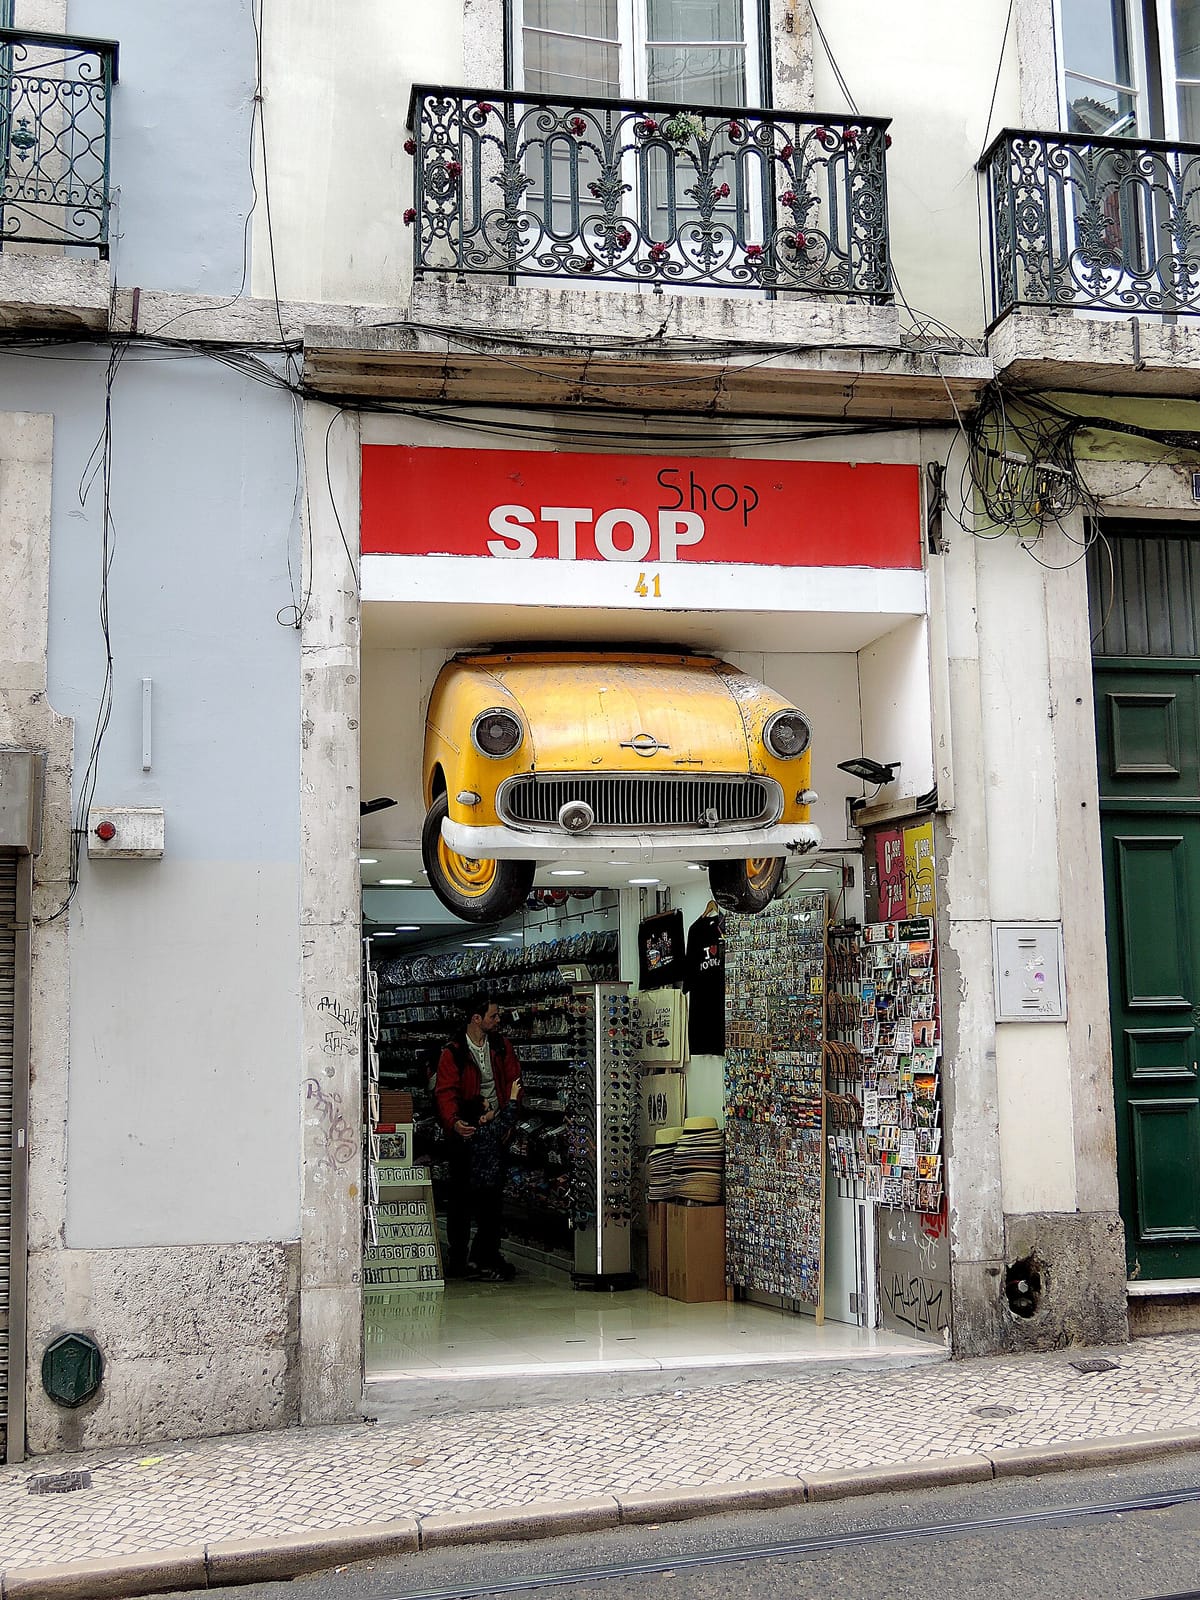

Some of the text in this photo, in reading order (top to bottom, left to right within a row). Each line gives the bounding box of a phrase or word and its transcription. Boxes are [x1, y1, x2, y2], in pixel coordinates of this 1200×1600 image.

[657, 469, 759, 528] Shop
[487, 505, 705, 561] STOP
[634, 574, 662, 598] 41
